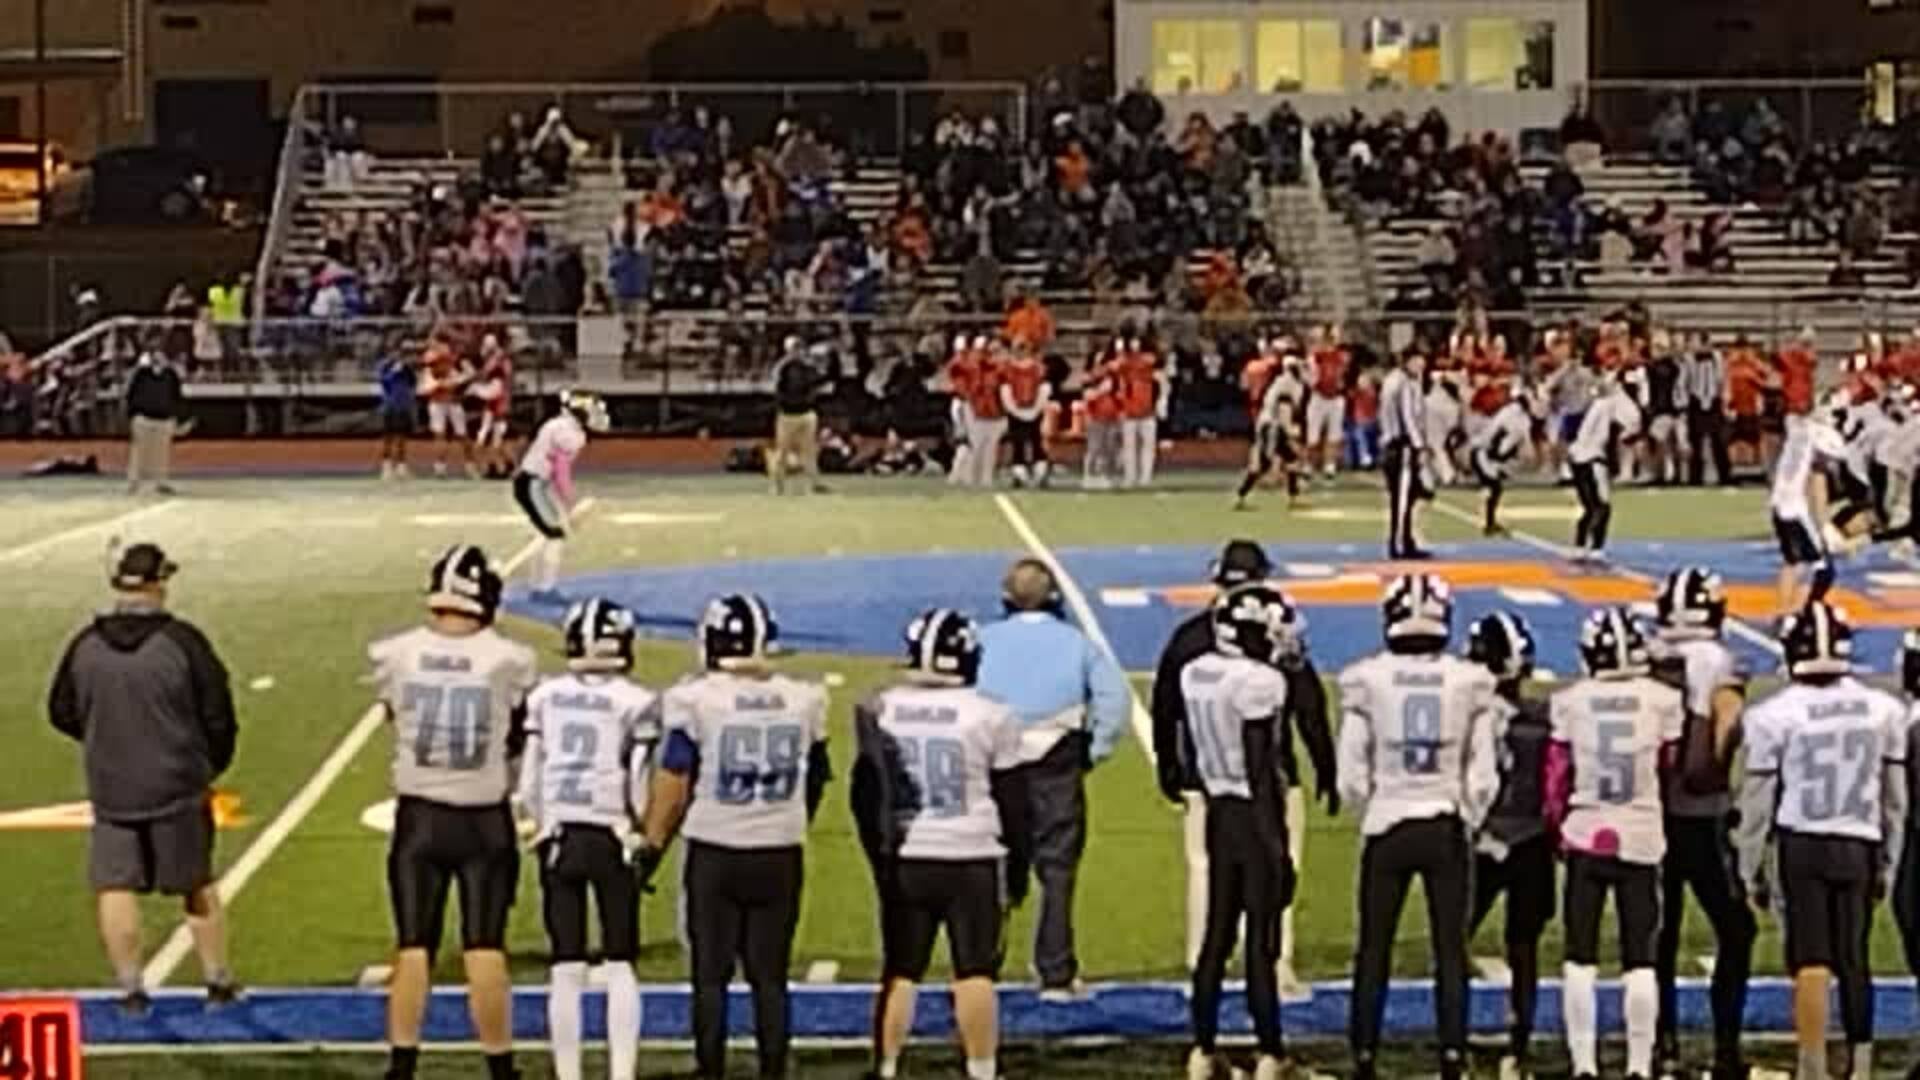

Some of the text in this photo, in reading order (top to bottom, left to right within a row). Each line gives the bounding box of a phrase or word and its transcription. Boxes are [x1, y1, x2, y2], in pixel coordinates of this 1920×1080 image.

[559, 721, 599, 804] 2
[1597, 720, 1633, 804] 5
[1799, 729, 1875, 820] 52
[0, 1012, 70, 1080] 40
